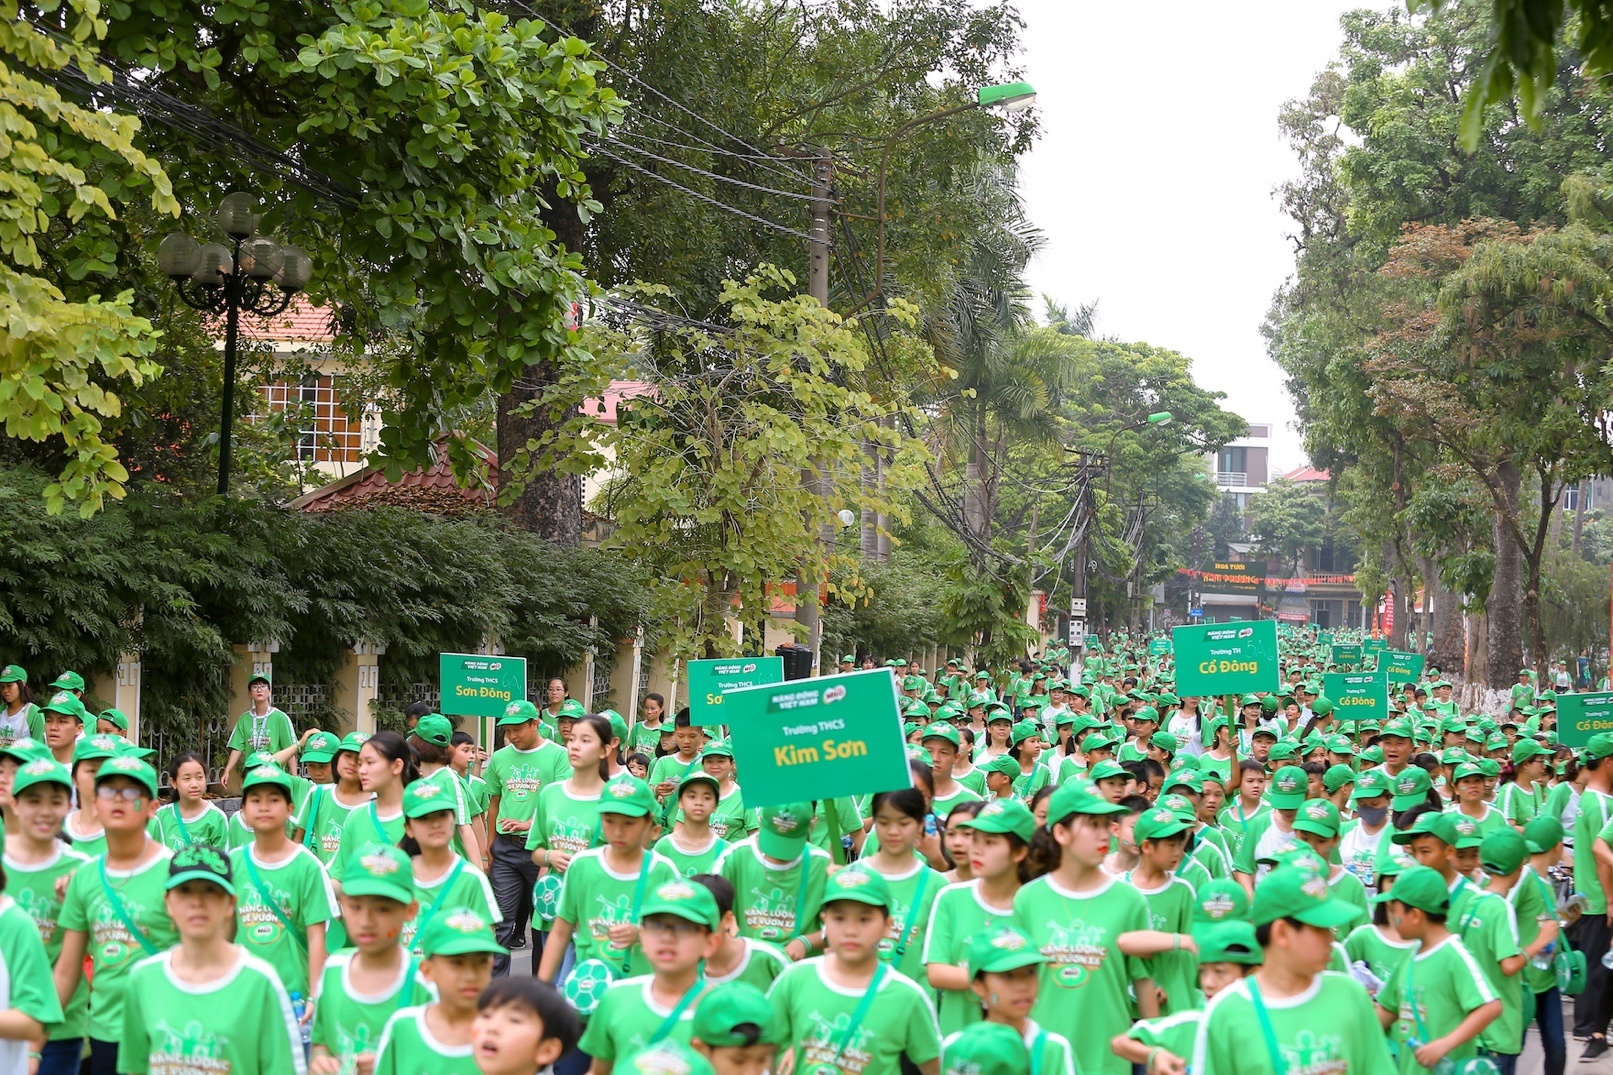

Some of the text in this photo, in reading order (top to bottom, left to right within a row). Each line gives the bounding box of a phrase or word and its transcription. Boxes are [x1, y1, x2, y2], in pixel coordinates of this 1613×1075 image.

[1199, 659, 1258, 674] Cổ Đông
[1396, 666, 1411, 675] Đông
[456, 685, 511, 702] Sơn Đông
[706, 693, 724, 705] Sơ
[799, 698, 818, 707] NAM
[1339, 695, 1375, 706] Cổ Đông
[782, 719, 845, 737] Trường THCS
[1576, 719, 1590, 730] Cổ
[774, 739, 868, 767] Kim Sơn
[770, 910, 794, 919] LƯỢN
